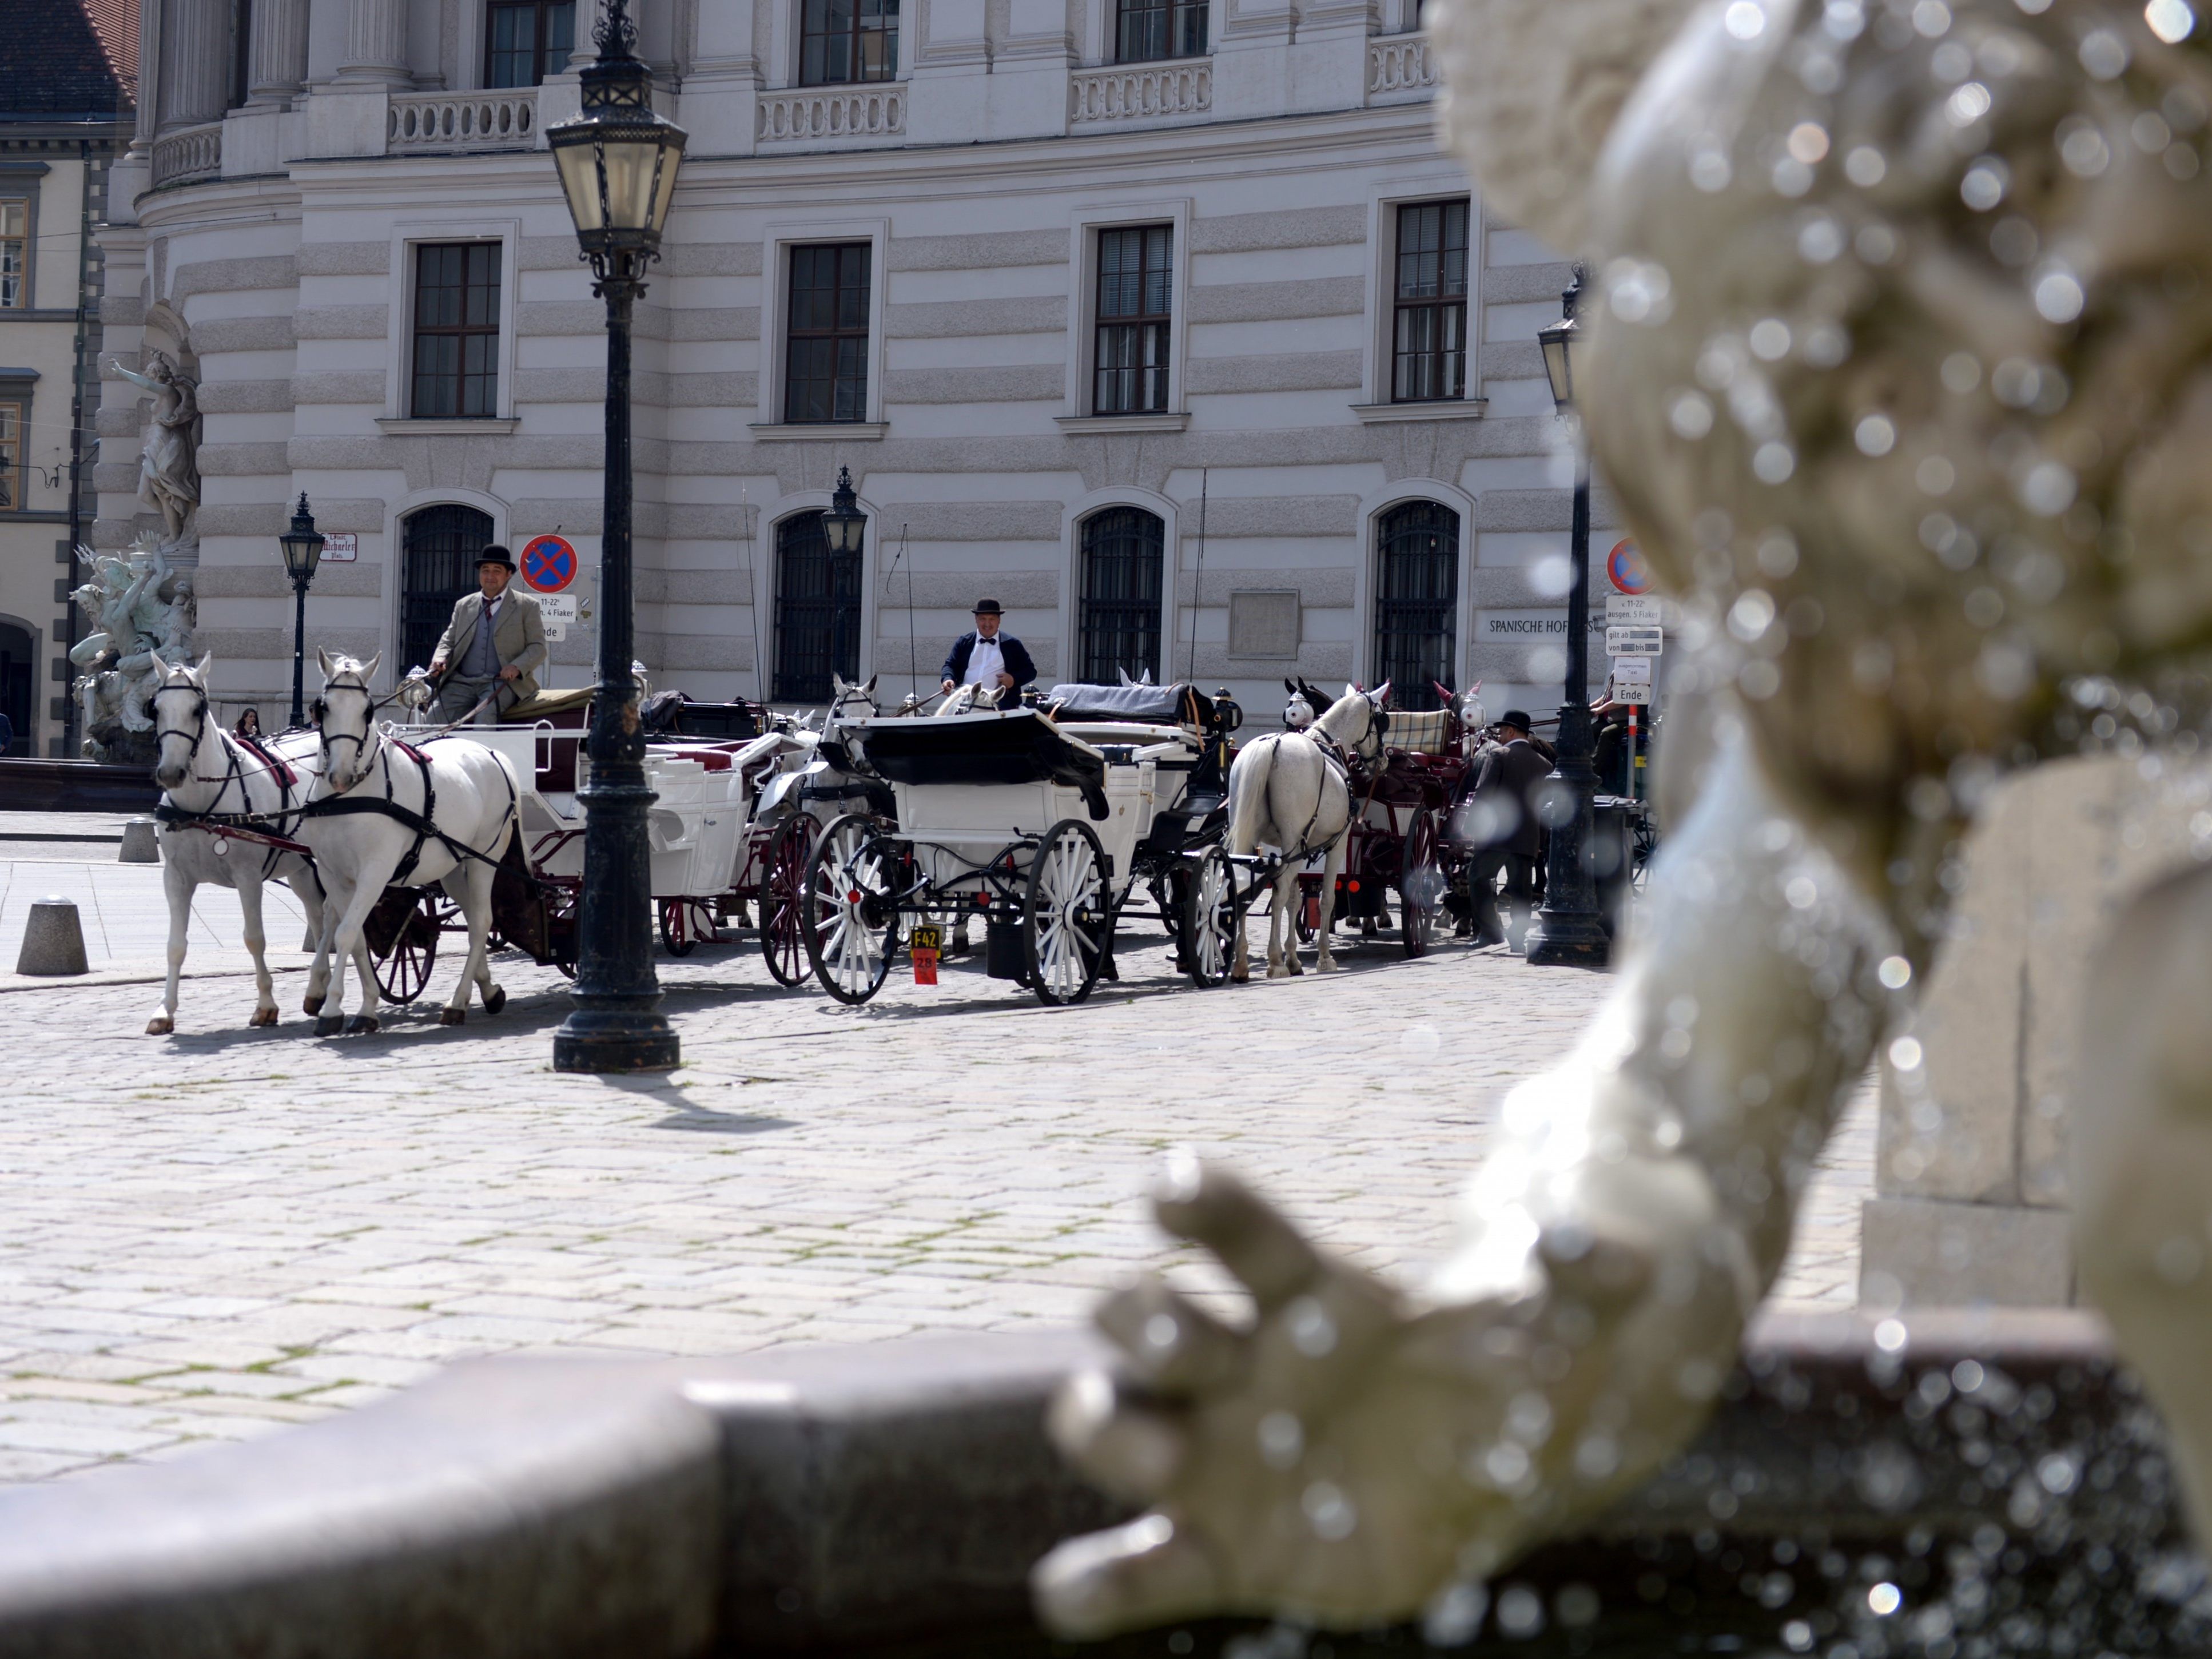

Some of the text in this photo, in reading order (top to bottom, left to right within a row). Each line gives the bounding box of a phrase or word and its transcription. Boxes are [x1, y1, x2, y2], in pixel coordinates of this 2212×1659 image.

[1639, 610, 1658, 618] Fiaker
[1490, 620, 1543, 632] SPANISCHE
[1609, 631, 1620, 640] gilt
[1621, 690, 1641, 699] Ende
